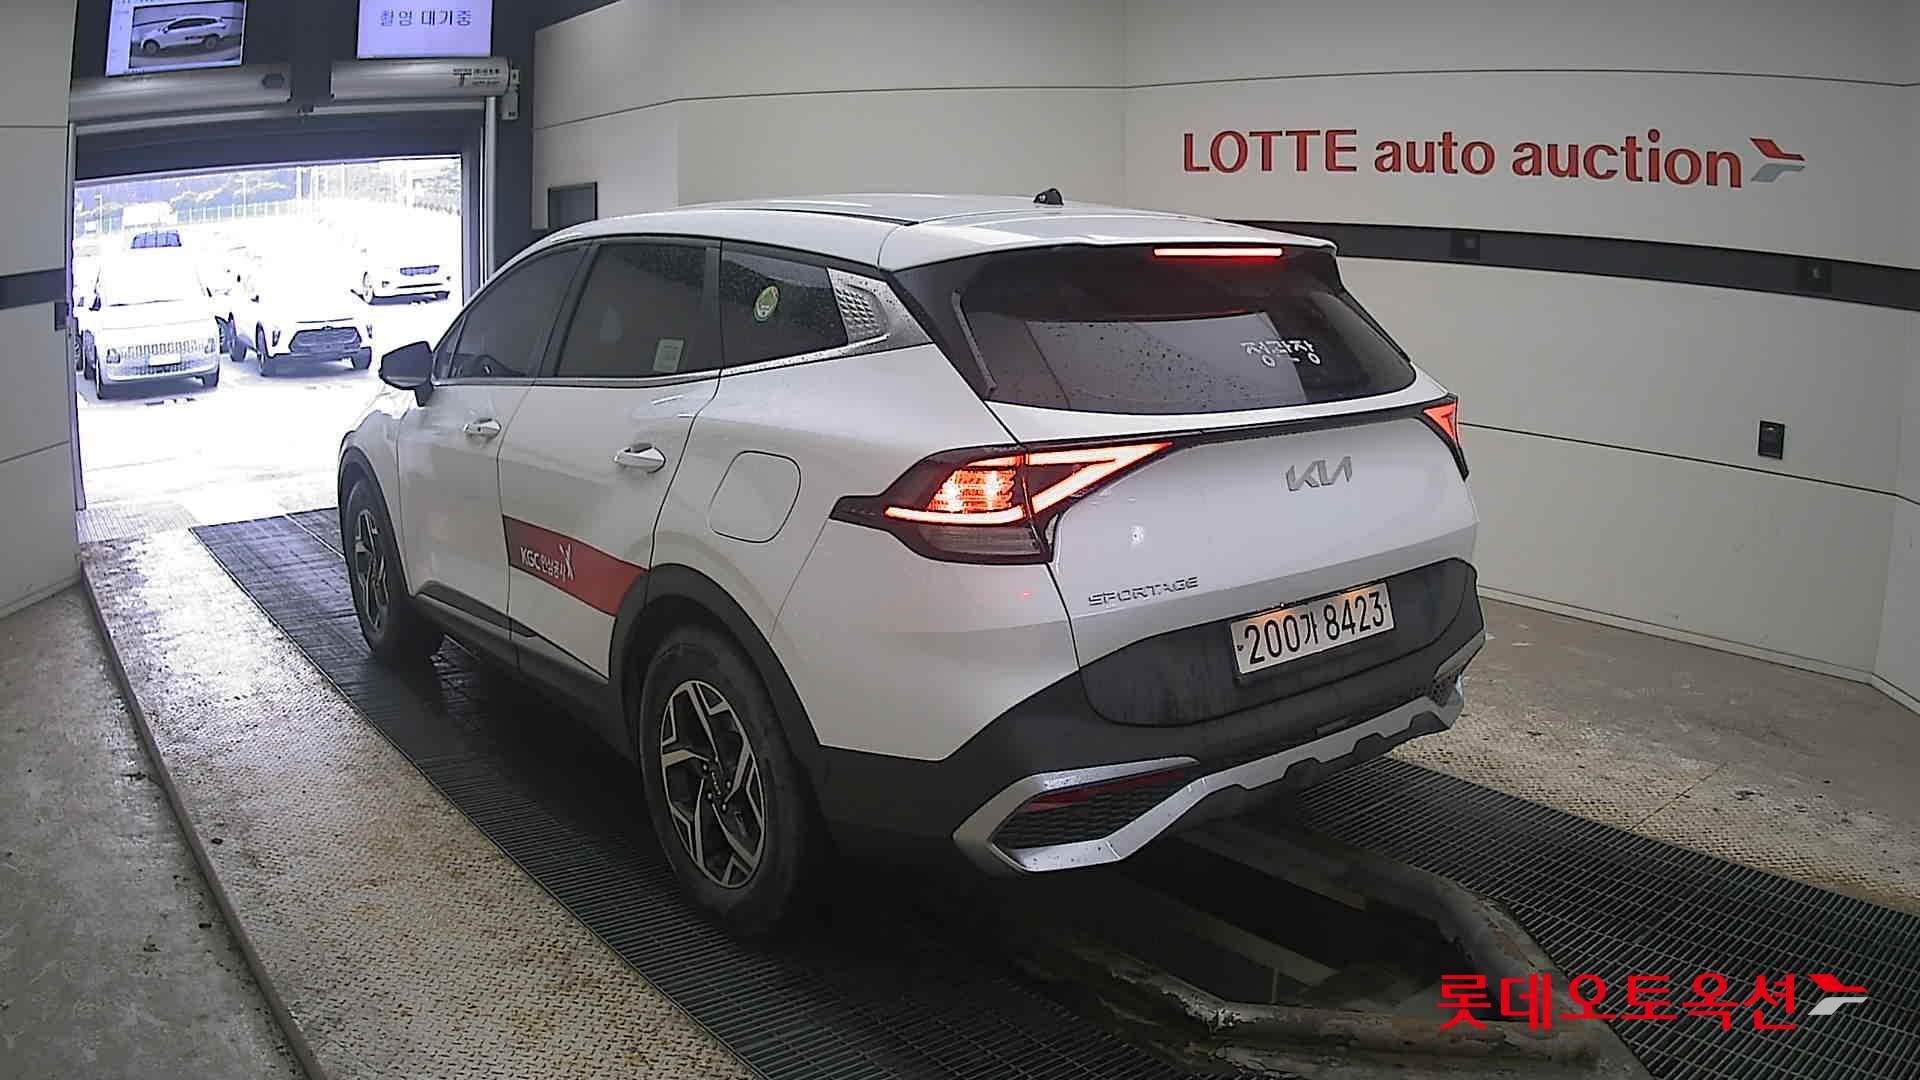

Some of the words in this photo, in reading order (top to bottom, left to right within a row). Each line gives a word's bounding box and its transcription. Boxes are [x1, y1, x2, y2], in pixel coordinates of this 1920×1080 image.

[421, 10, 472, 26] 대기중
[1183, 129, 1358, 172] LOTTE
[1374, 132, 1495, 174] auto
[1511, 129, 1742, 188] auction
[1088, 575, 1199, 606] SPORTAGE
[1244, 610, 1319, 665] 200가
[1323, 591, 1385, 641] 8423
